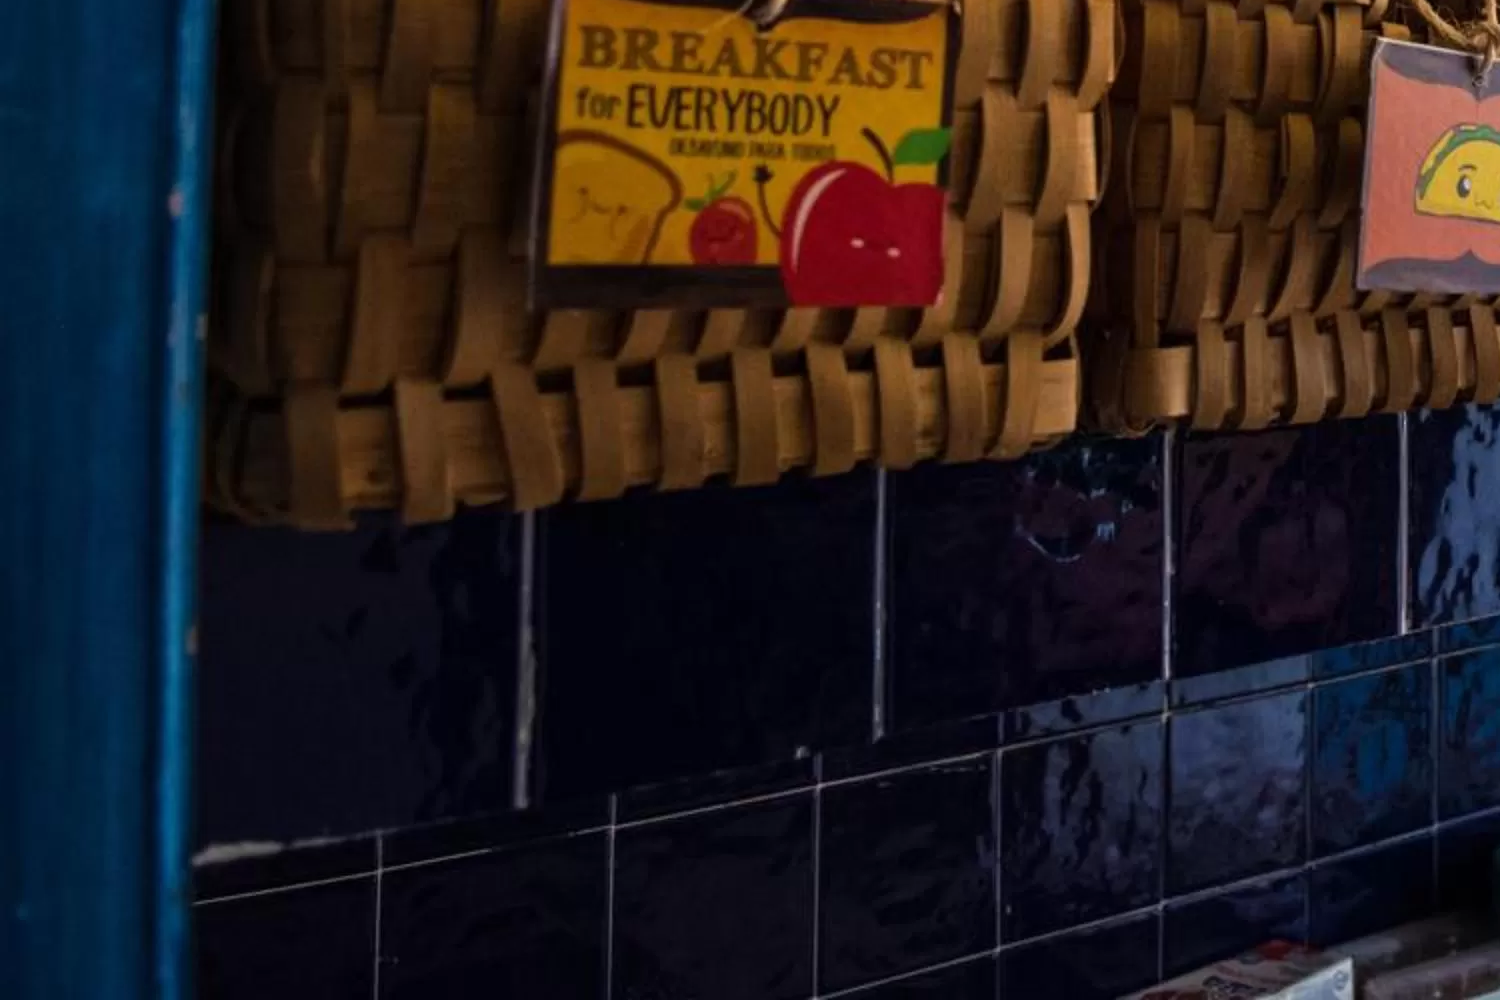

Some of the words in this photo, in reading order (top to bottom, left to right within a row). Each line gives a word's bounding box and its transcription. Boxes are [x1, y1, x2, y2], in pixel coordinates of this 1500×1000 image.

[577, 25, 933, 90] BREAKFAST
[575, 85, 620, 119] for
[627, 83, 840, 137] EVERYBODY
